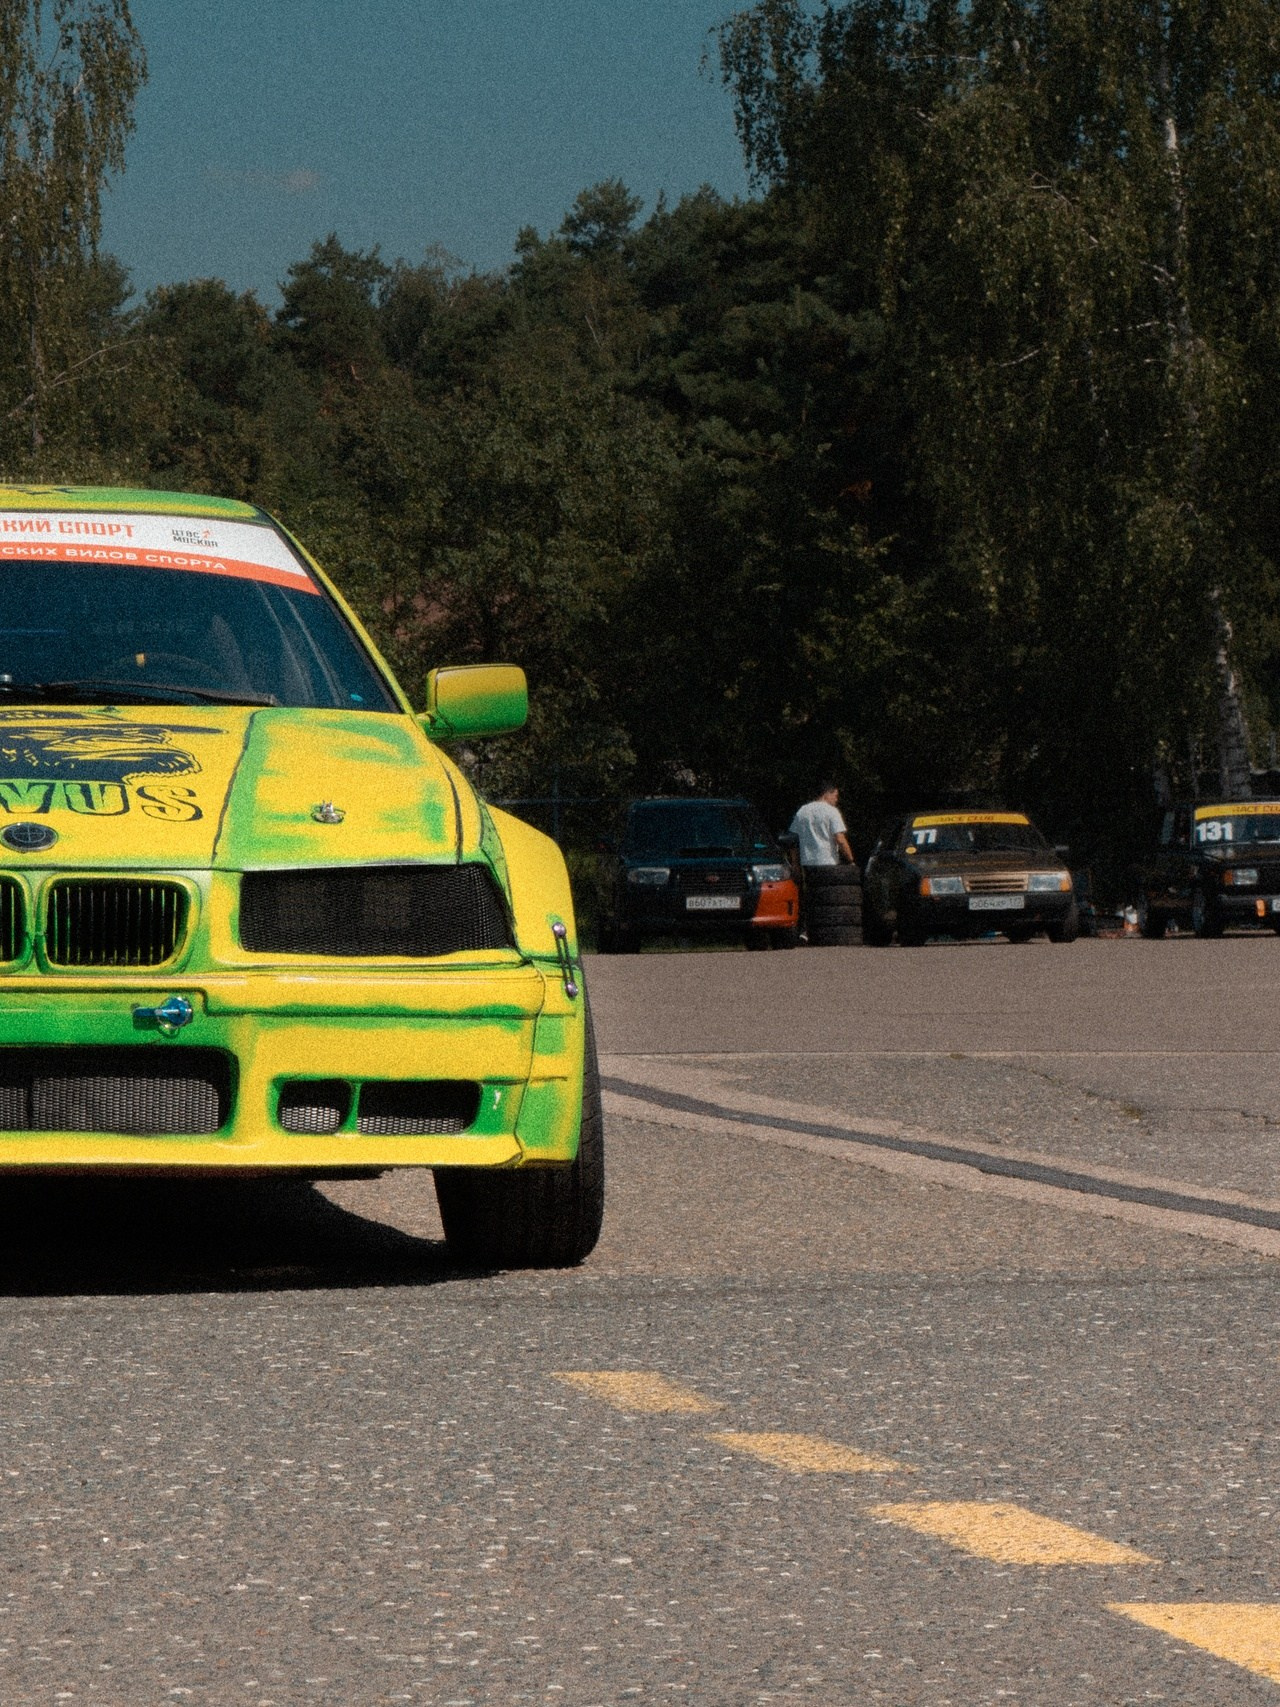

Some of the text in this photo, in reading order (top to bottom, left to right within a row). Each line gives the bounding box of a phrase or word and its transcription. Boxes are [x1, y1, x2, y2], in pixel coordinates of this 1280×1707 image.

[58, 520, 136, 538] СПОРТ
[65, 548, 138, 561] ВИДОВ
[145, 554, 228, 571] СПОРТА
[1196, 821, 1233, 841] 131
